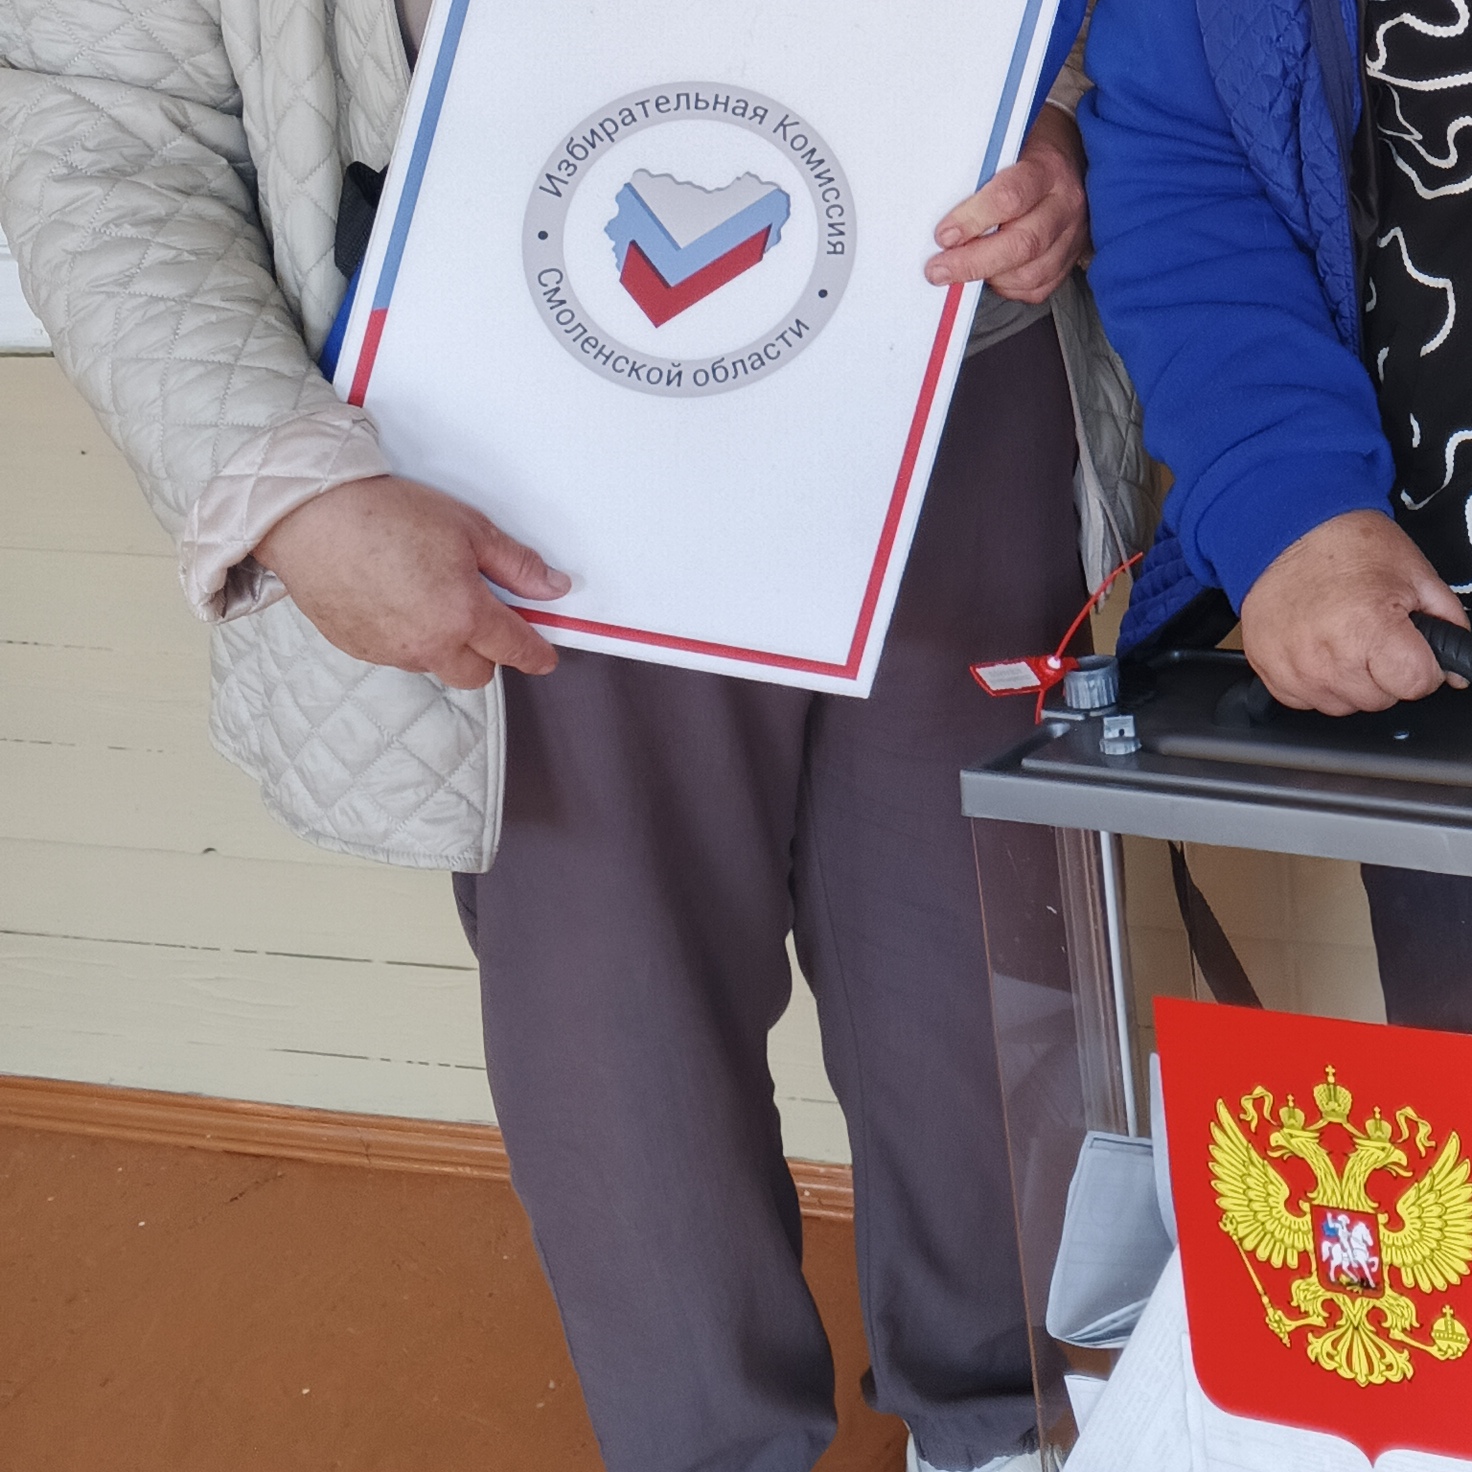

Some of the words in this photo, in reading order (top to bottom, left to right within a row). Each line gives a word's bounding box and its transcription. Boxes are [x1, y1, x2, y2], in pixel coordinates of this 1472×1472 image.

[539, 91, 769, 198] Избирательная
[772, 114, 846, 256] Комиссия
[537, 268, 683, 387] Смоленской
[692, 318, 810, 387] области
